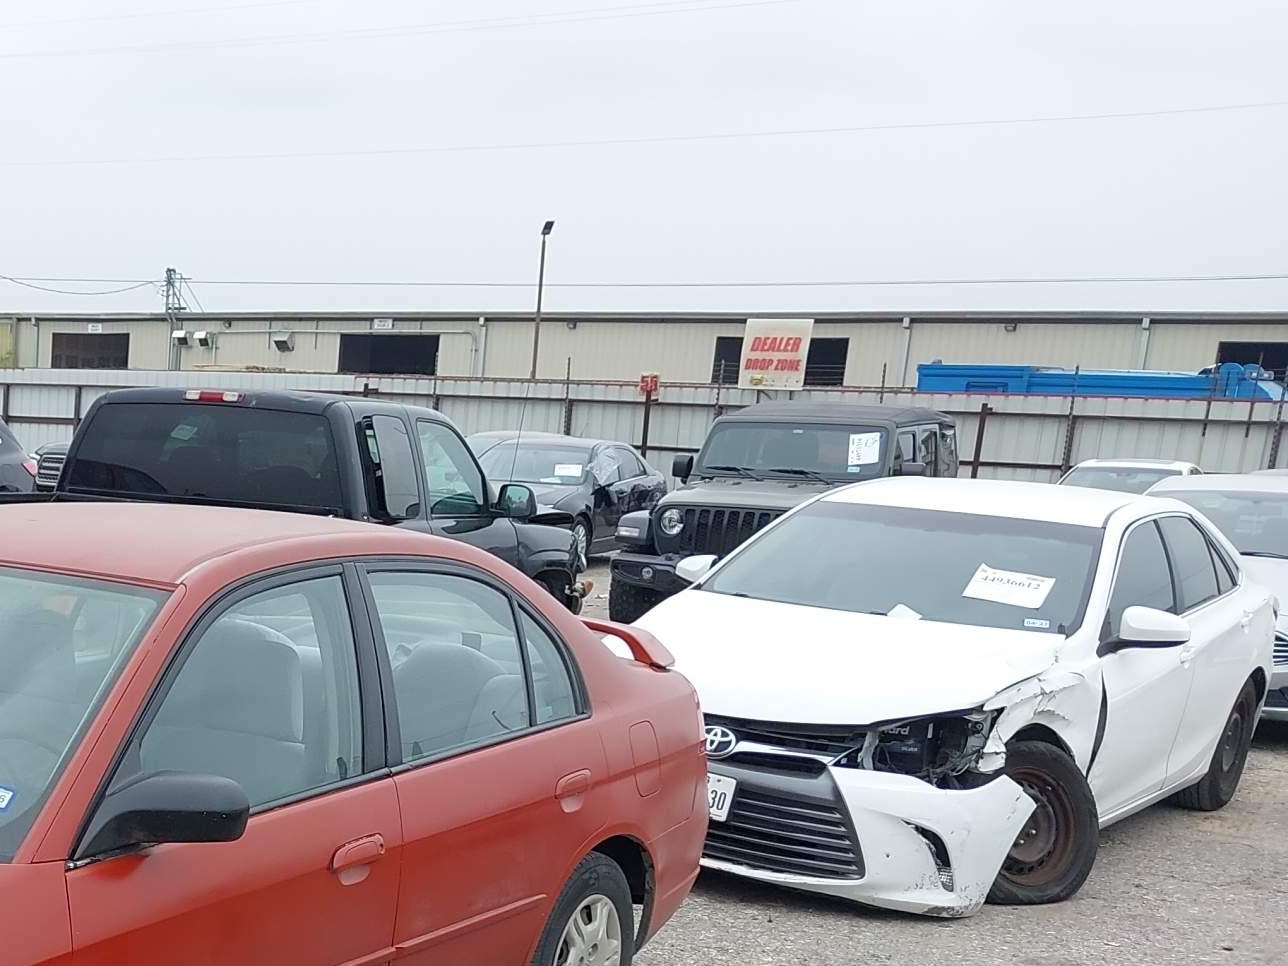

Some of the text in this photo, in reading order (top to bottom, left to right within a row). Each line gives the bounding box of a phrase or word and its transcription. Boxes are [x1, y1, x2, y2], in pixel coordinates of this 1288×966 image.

[750, 336, 802, 352] DEALER
[744, 359, 801, 371] DROP ZONE
[882, 726, 910, 735] ard
[709, 789, 727, 810] 30
